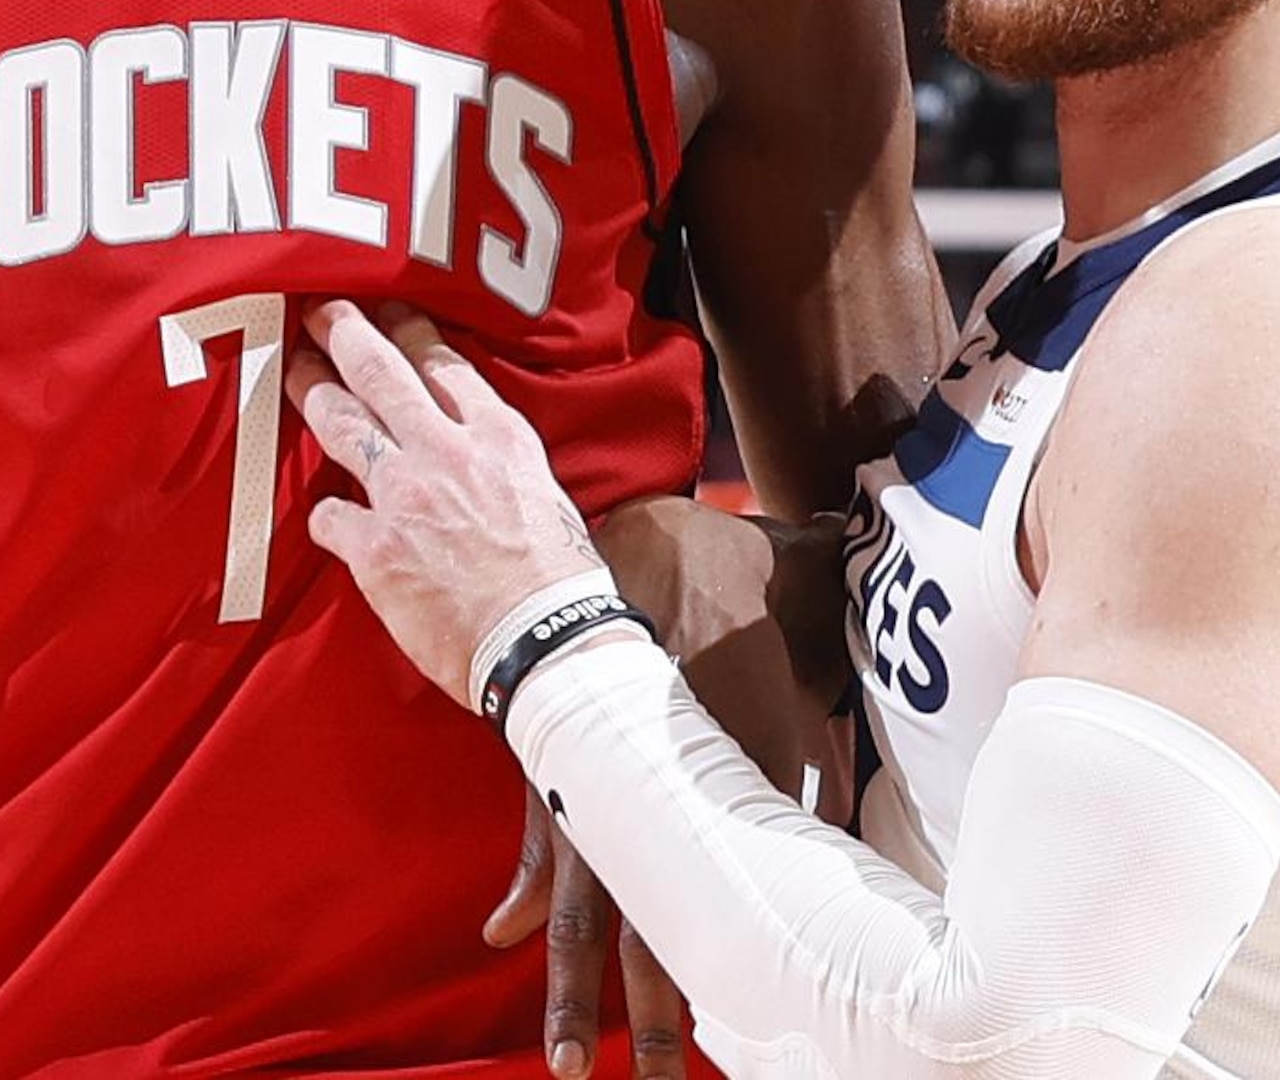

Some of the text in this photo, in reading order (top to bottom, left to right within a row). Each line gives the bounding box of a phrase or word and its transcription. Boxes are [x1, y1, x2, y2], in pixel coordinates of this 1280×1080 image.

[160, 292, 286, 625] 7
[532, 594, 627, 641] Believe
[847, 510, 952, 714] VES
